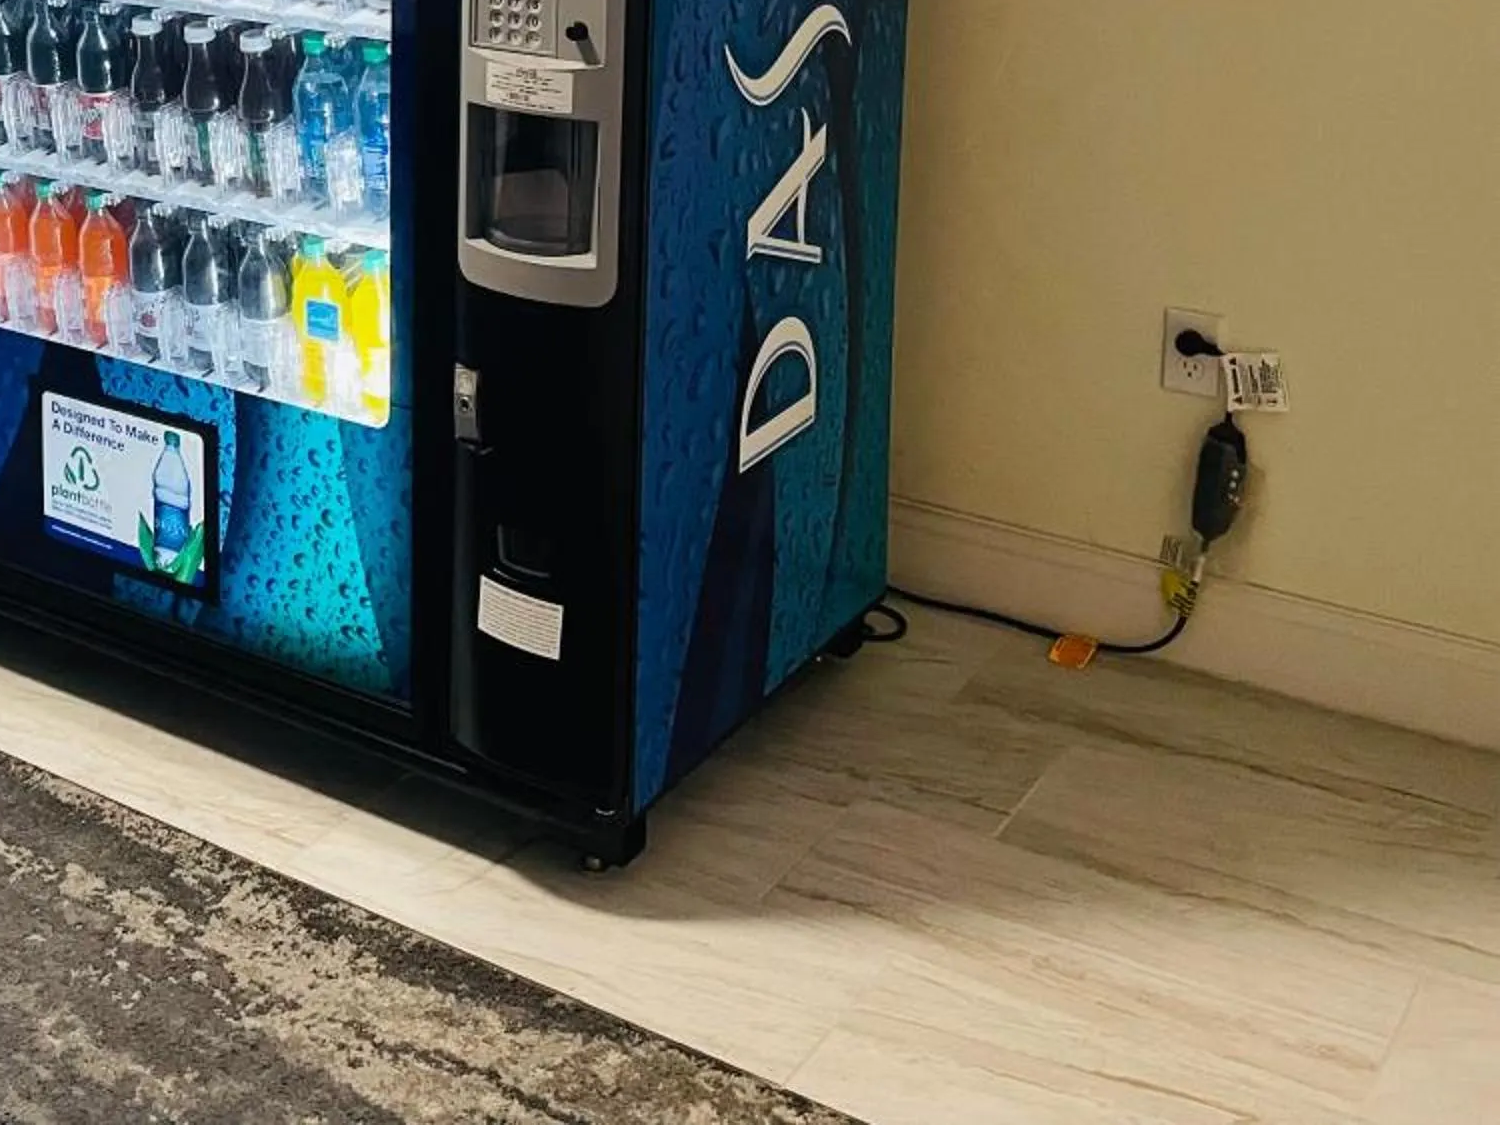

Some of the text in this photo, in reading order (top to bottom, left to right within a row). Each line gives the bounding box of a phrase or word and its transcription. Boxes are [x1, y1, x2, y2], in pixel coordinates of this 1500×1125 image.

[51, 400, 159, 446] Designed To Make
[52, 418, 125, 452] A Difference
